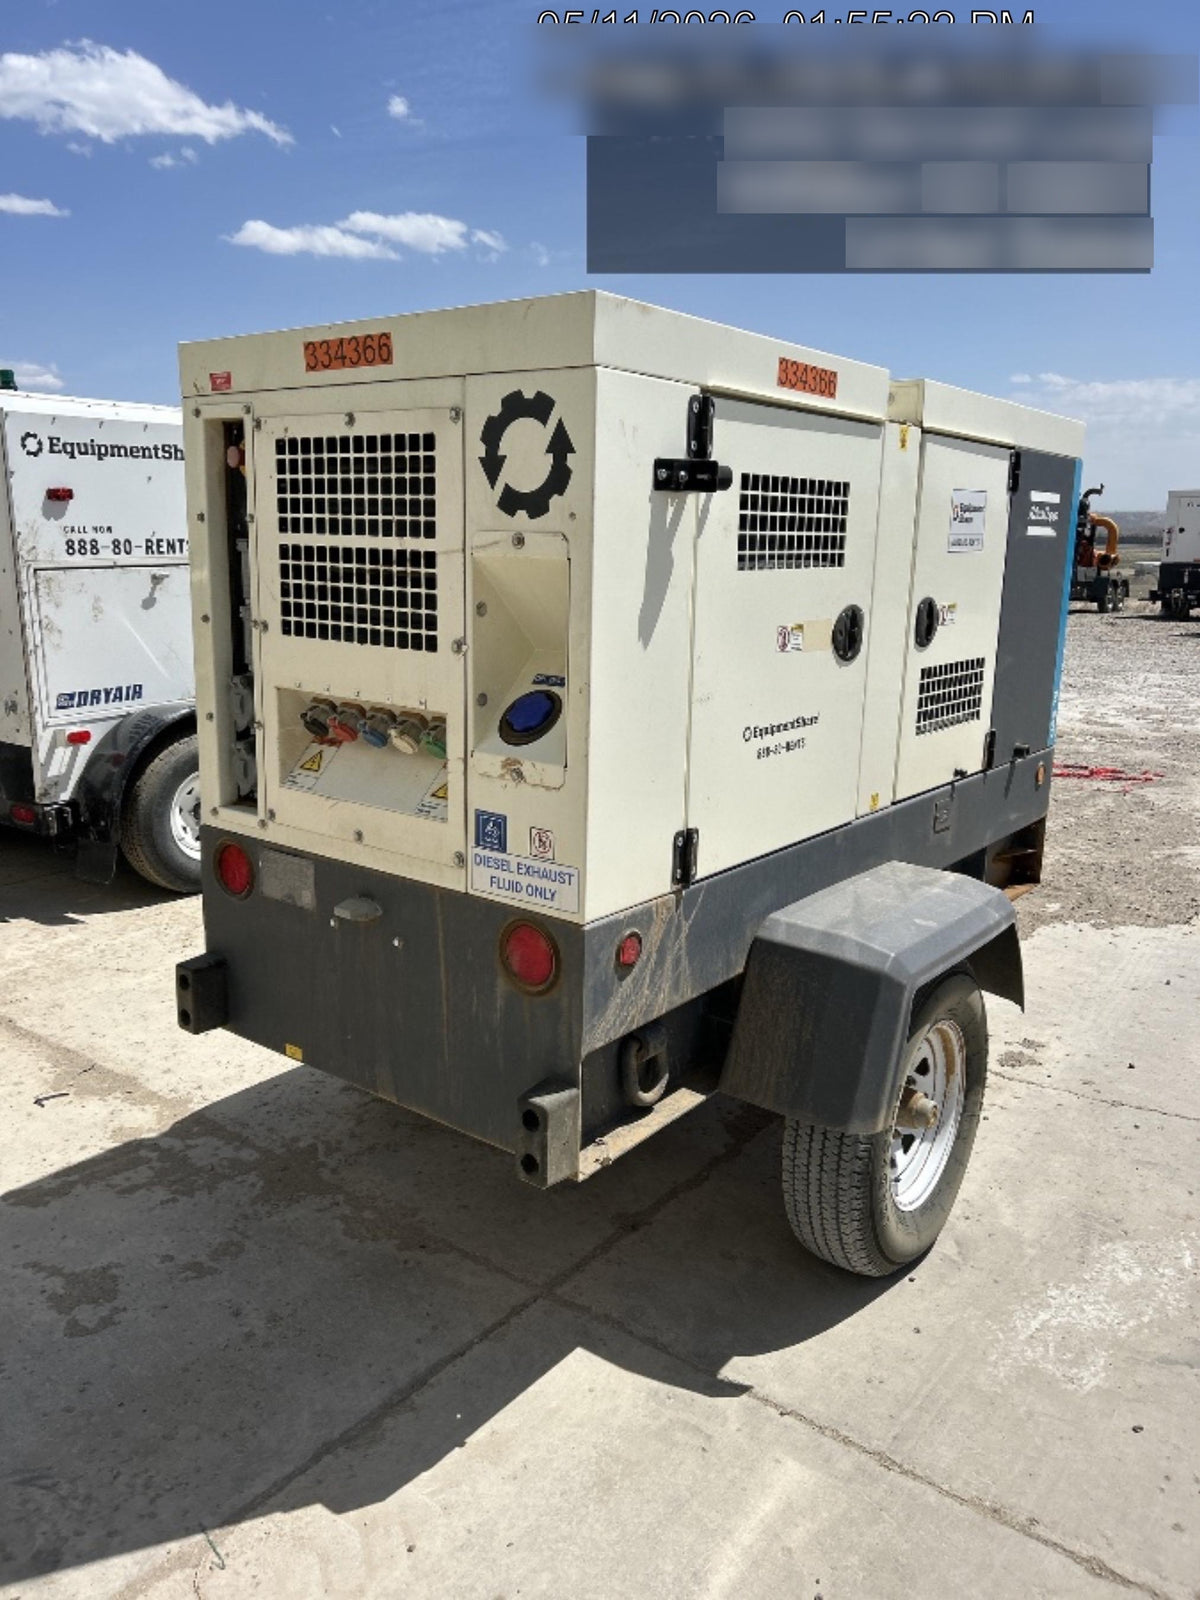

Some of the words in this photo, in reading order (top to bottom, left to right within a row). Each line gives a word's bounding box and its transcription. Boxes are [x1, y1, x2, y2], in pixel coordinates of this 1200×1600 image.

[305, 332, 392, 370] 334366
[779, 358, 837, 398] 334366
[63, 525, 88, 535] CALL
[65, 538, 189, 556] 888-80-RENT
[76, 683, 143, 708] DRYAIR
[474, 853, 514, 874] DIESEL
[517, 862, 575, 886] EXHAUST
[490, 876, 523, 894] FLUID
[526, 884, 558, 902] ONLY
